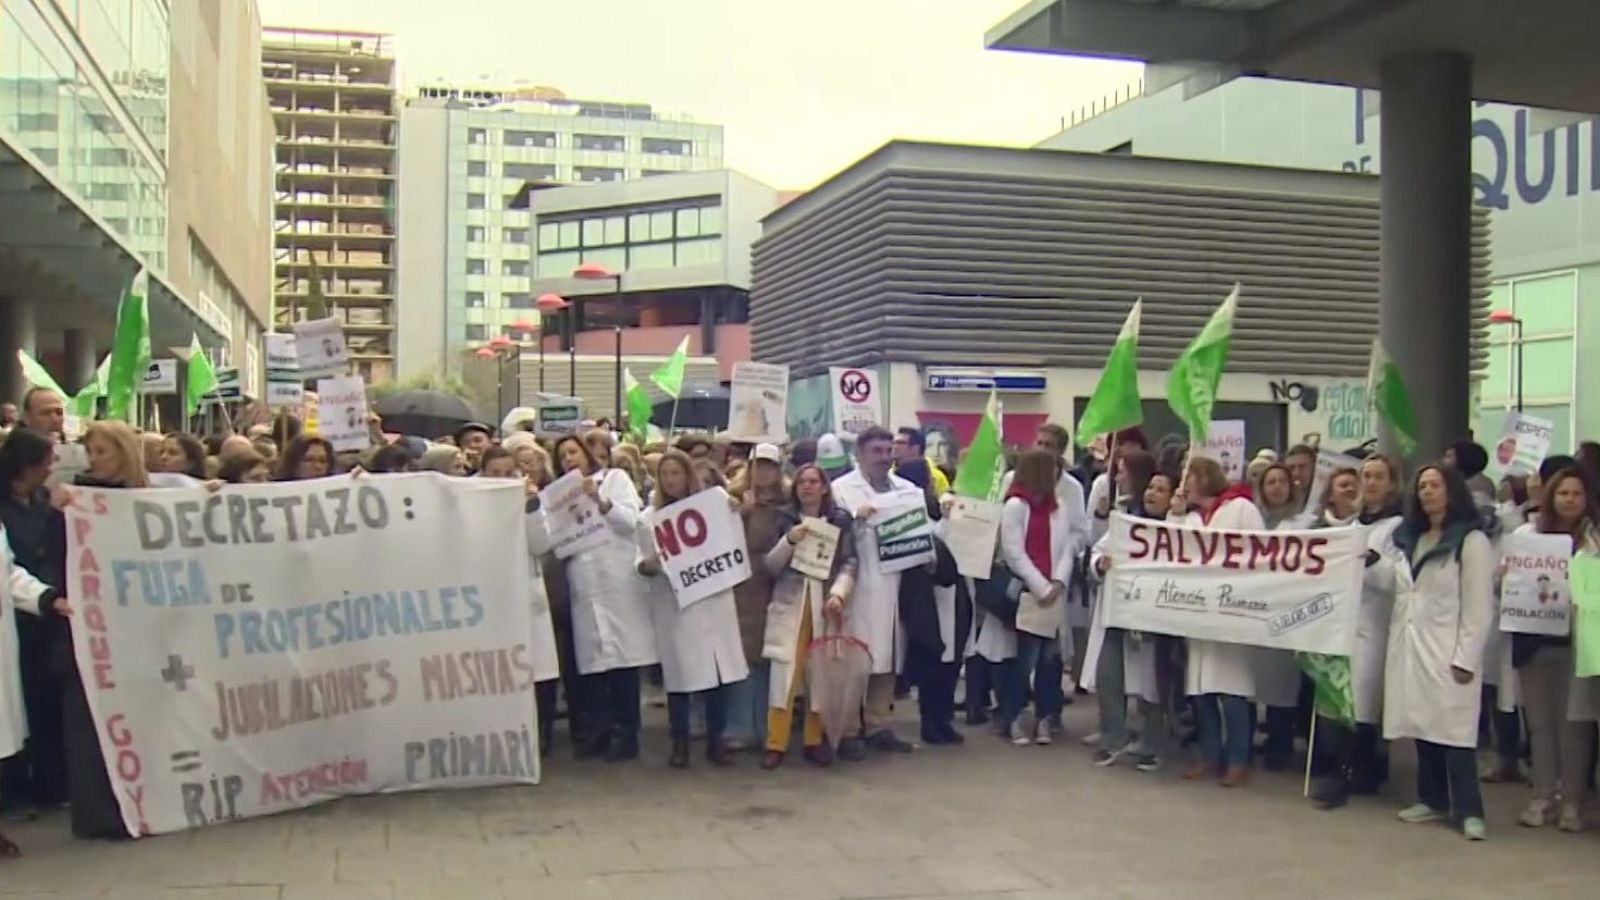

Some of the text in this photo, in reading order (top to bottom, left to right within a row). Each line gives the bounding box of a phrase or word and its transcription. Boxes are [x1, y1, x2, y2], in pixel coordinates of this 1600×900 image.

[132, 485, 389, 551] DECRETAZO
[654, 508, 708, 562] NO
[680, 548, 744, 588] DECRETO
[1129, 523, 1329, 576] SALVEMOS
[1504, 555, 1569, 571] ENGAÑO
[111, 559, 254, 607] FUGA DE
[212, 584, 486, 659] PROFESIONALES
[418, 643, 536, 703] MASIVAS
